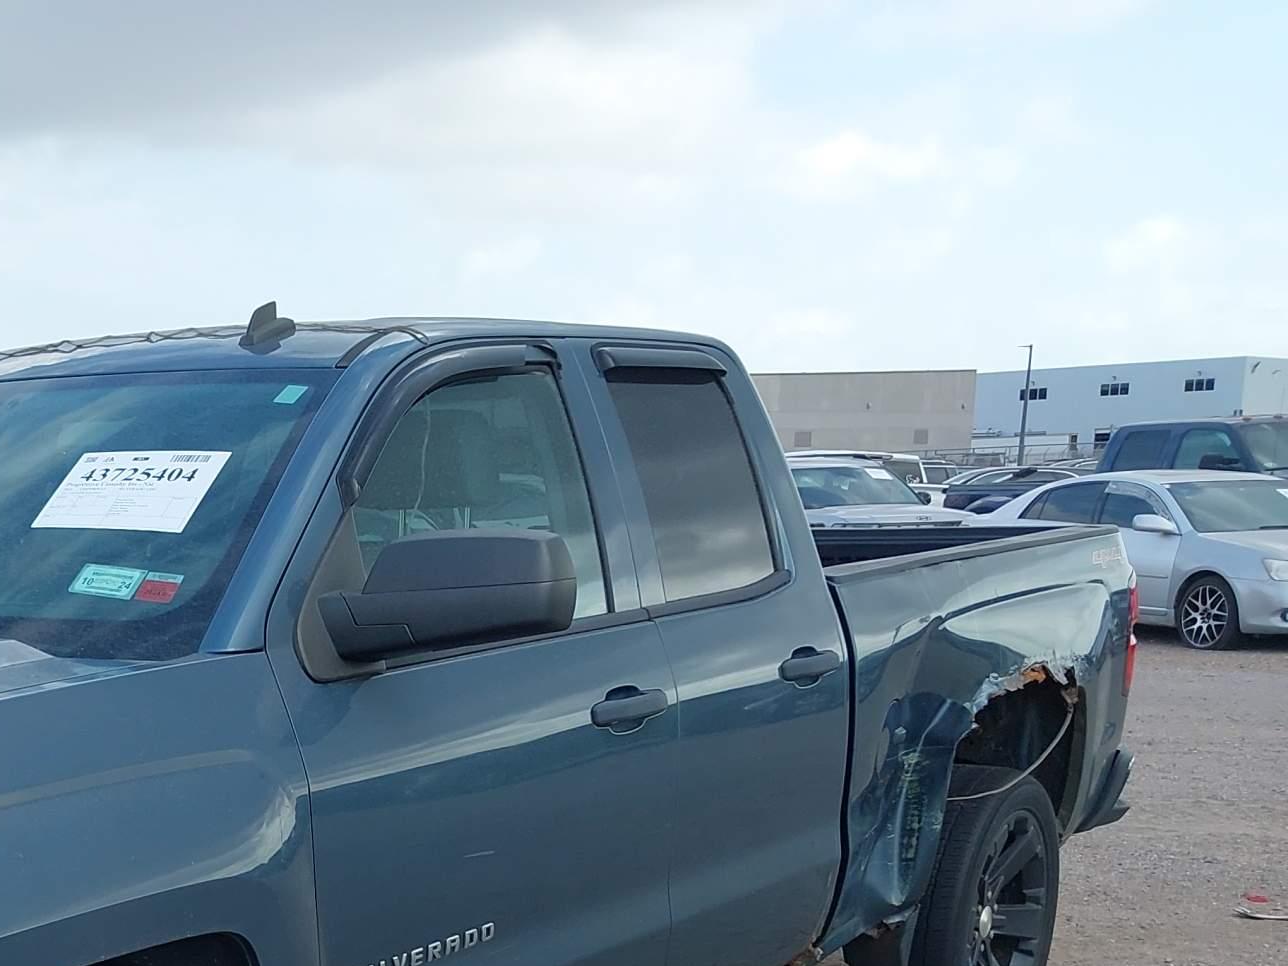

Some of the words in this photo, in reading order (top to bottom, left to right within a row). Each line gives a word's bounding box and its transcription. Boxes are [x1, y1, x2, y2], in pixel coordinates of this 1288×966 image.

[81, 468, 198, 482] 43725404
[82, 577, 95, 586] 10
[118, 581, 132, 590] 24
